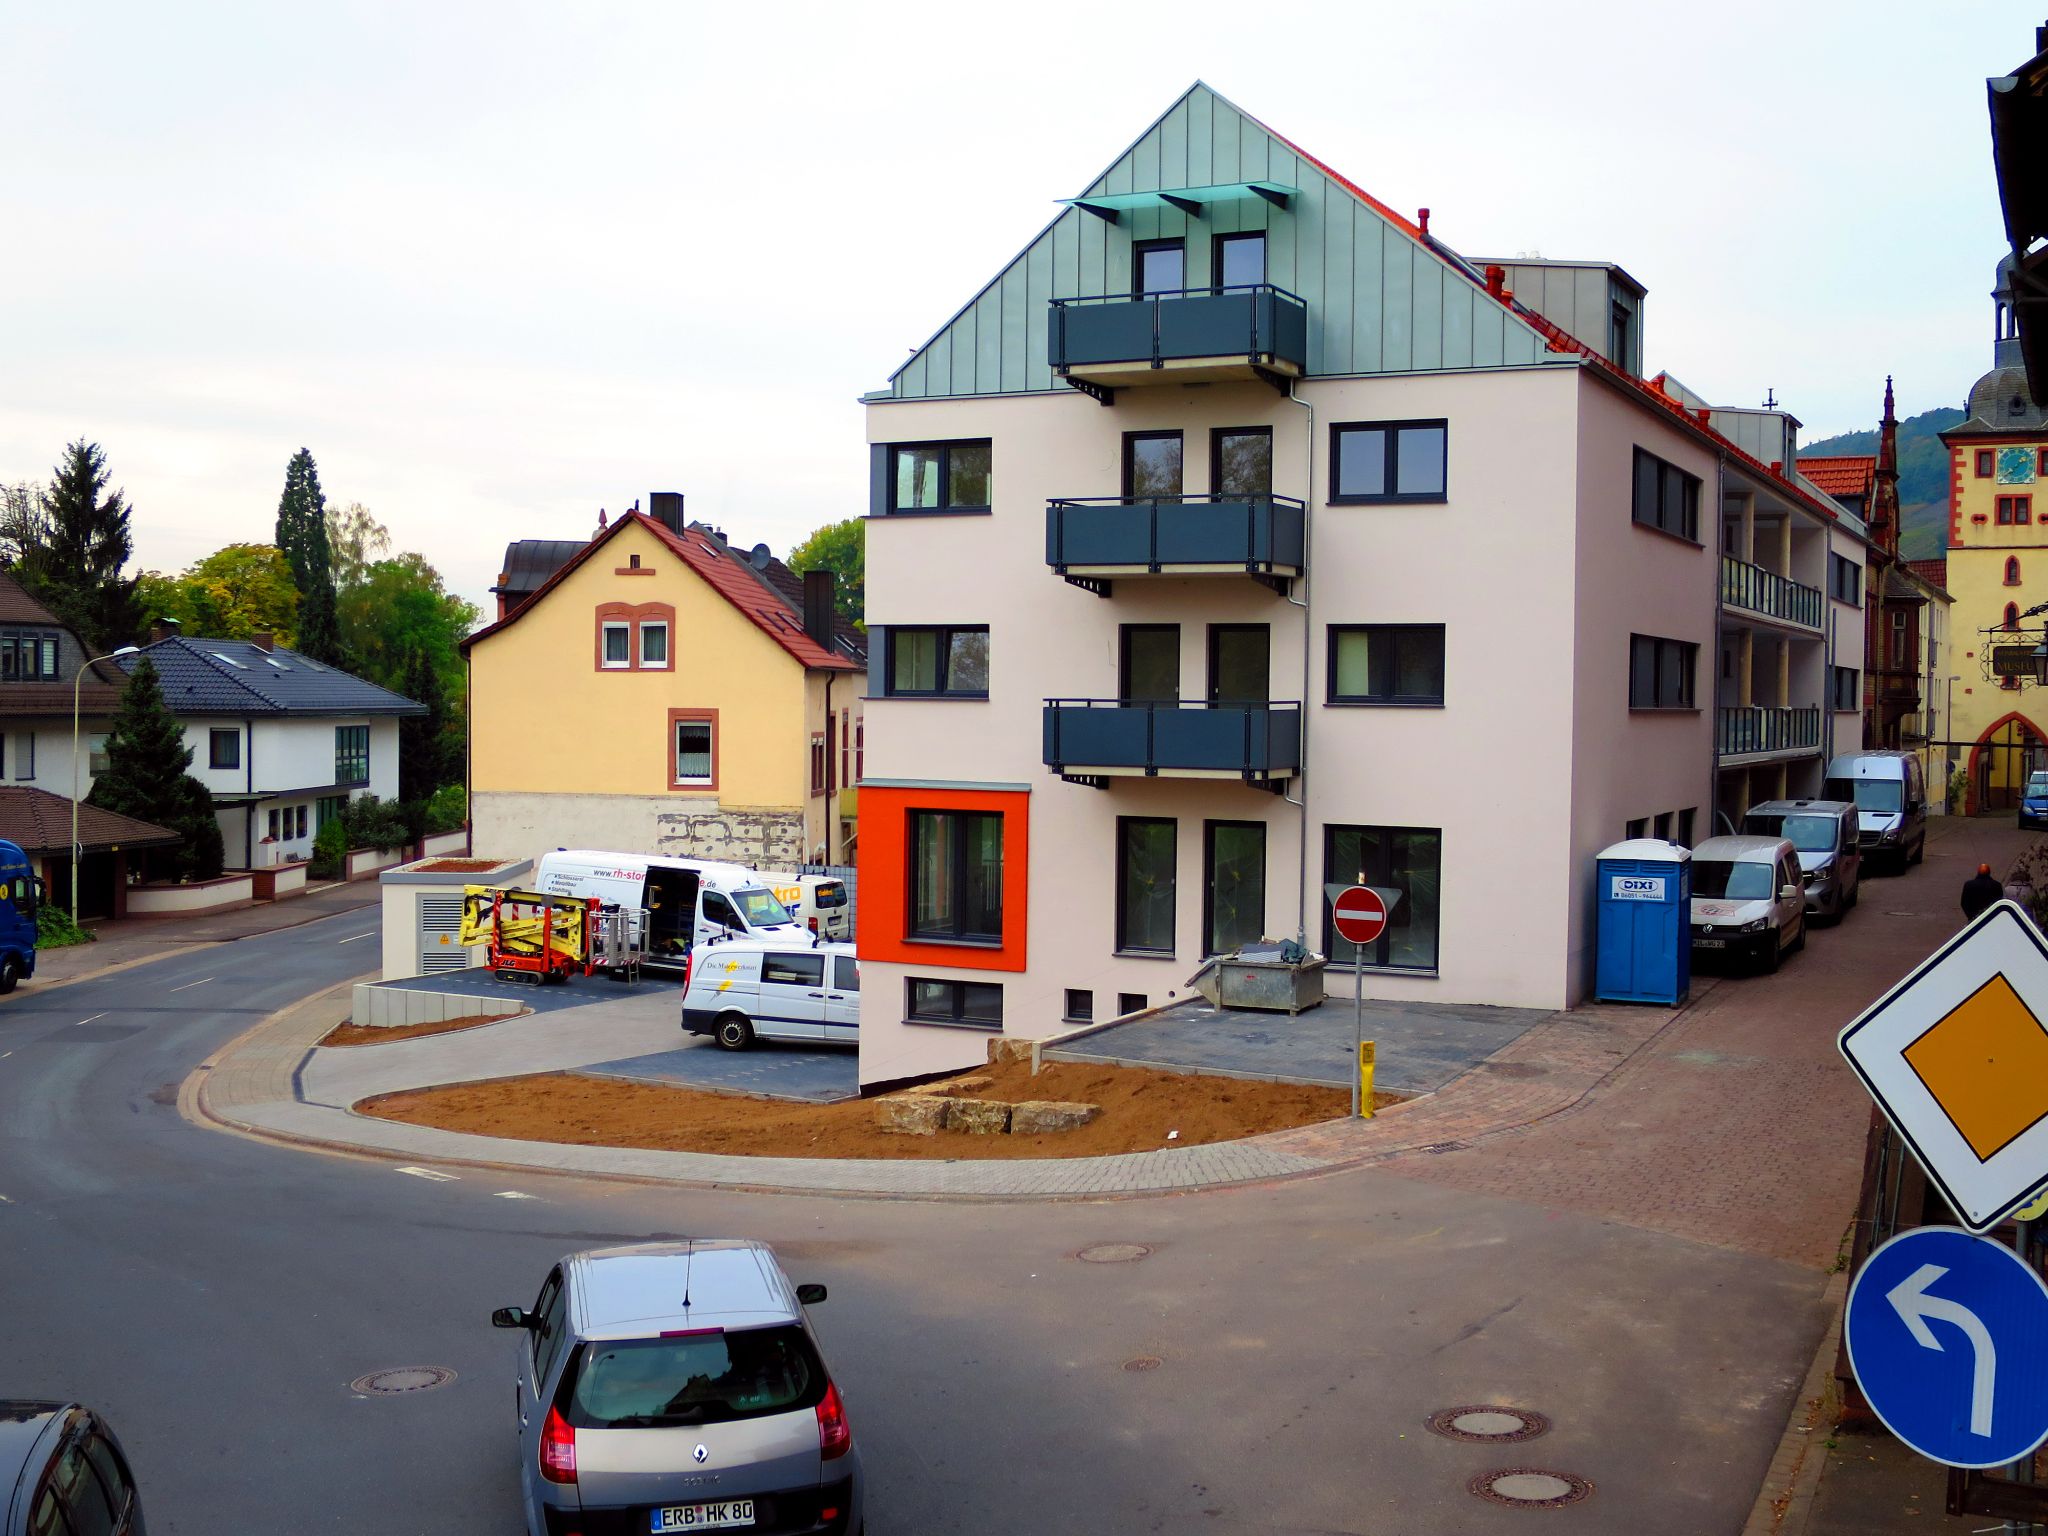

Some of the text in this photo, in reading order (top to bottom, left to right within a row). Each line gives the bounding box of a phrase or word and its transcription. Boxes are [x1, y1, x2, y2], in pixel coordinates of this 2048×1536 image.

[662, 1502, 753, 1526] ERB HK 80
